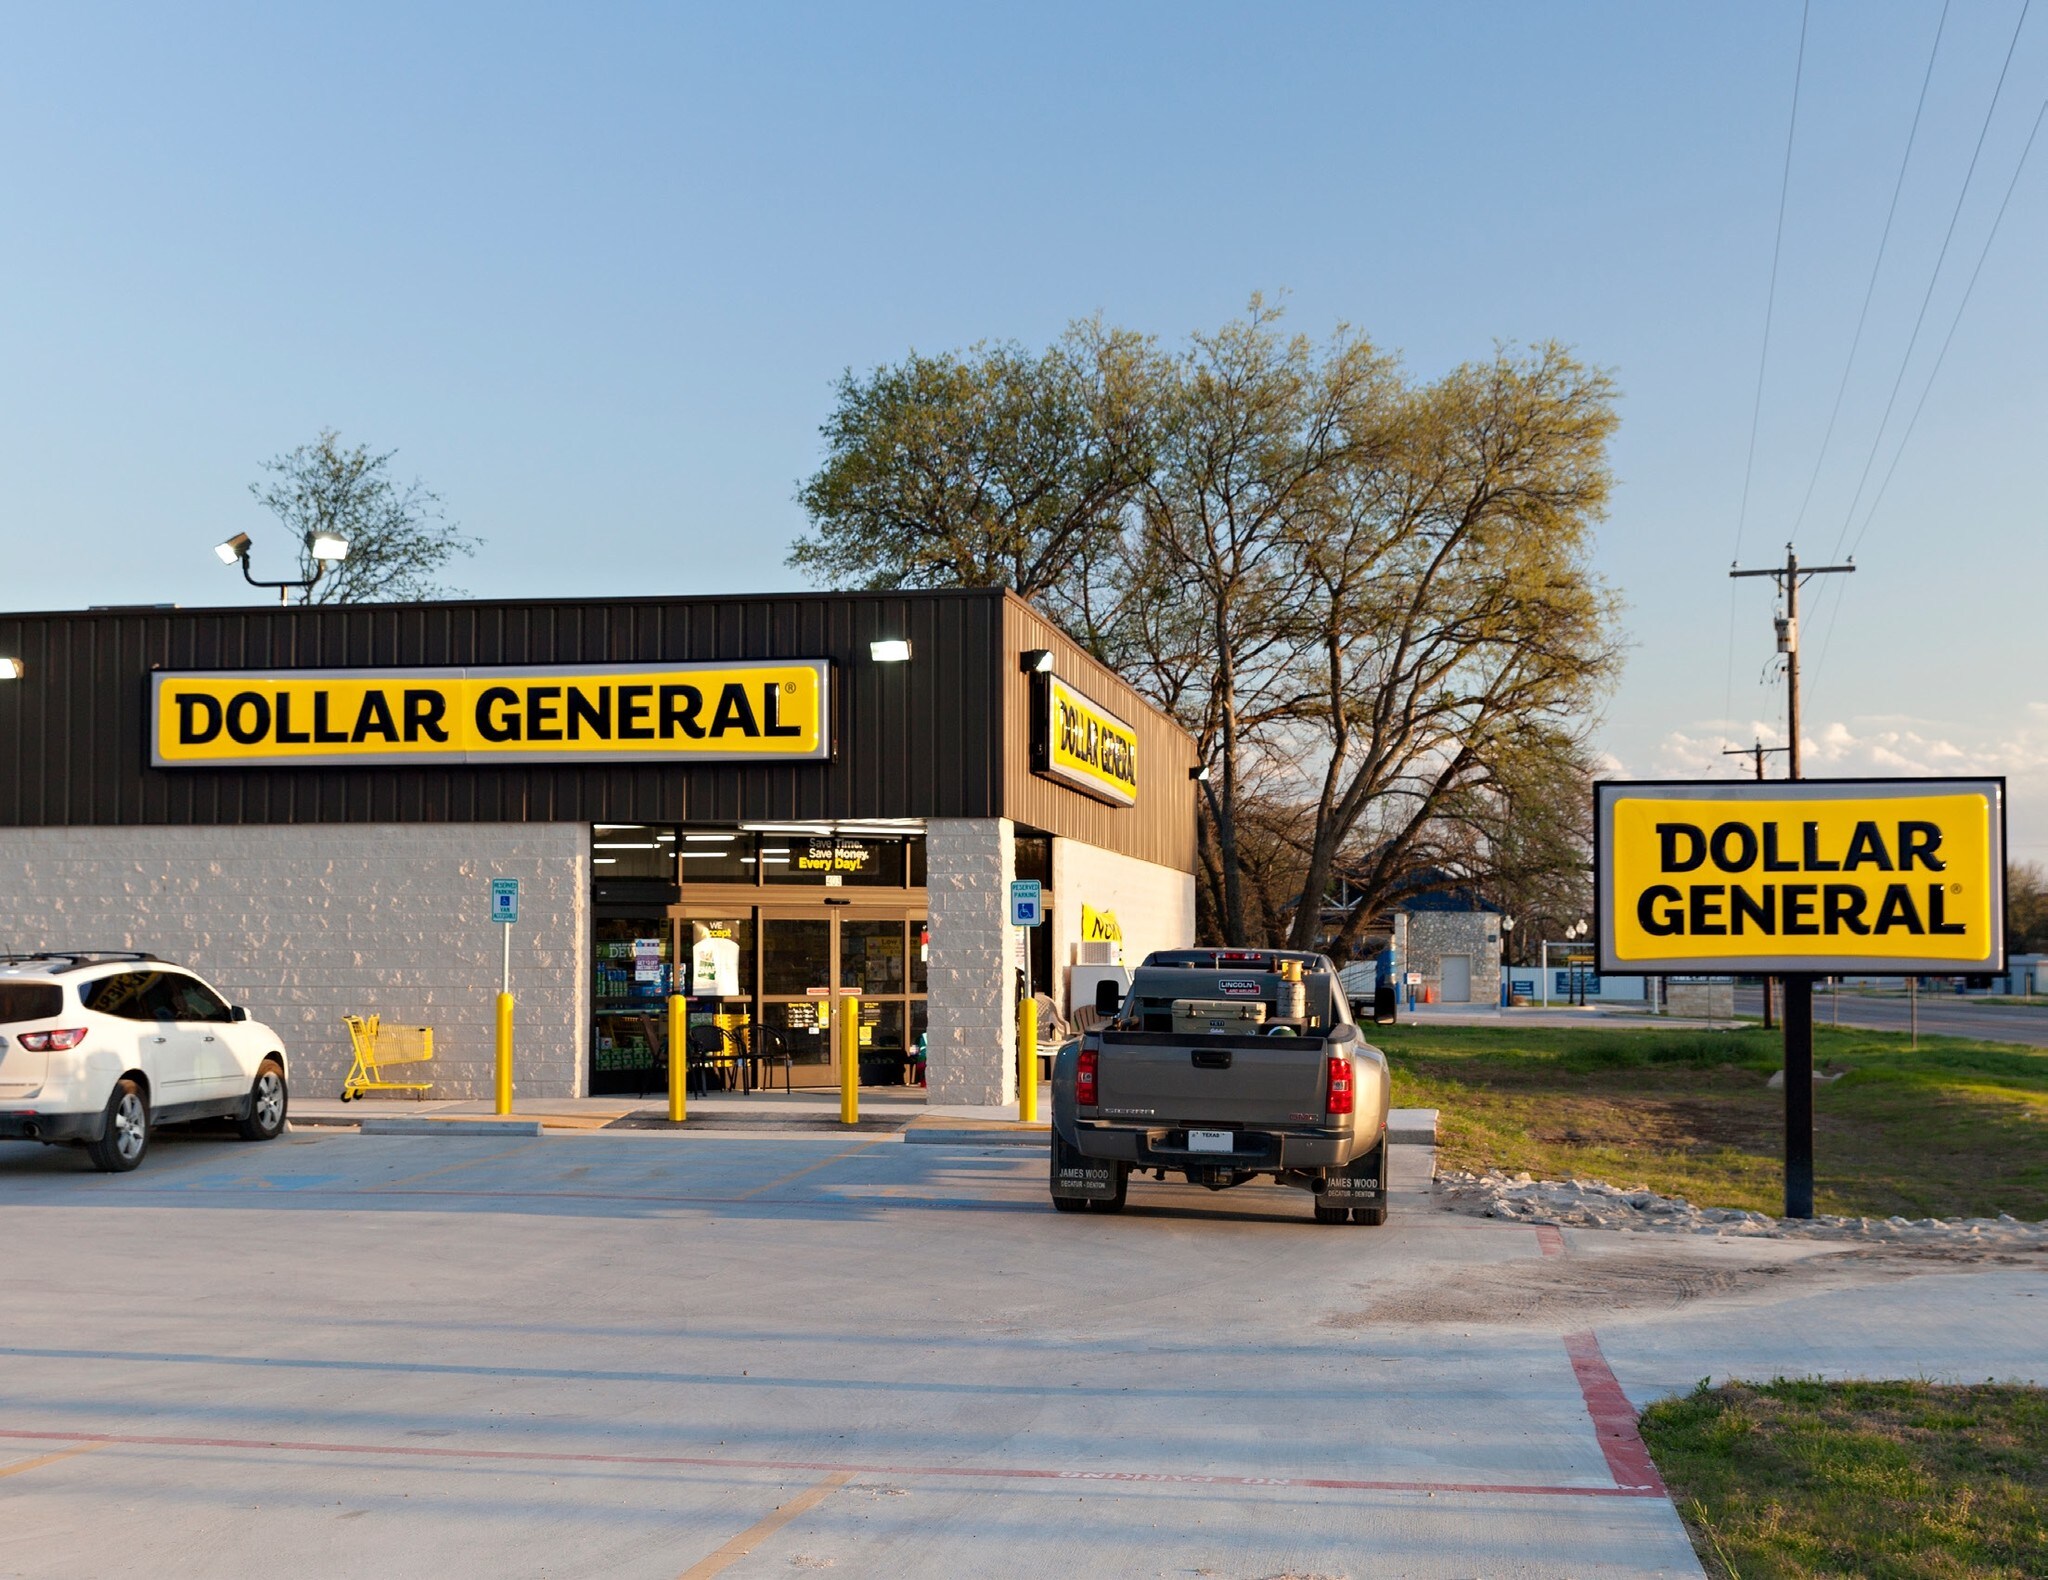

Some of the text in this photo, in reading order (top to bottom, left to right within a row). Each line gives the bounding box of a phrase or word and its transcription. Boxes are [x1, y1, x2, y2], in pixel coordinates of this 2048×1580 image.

[175, 690, 450, 746] DOLLAR
[474, 682, 801, 743] GENERAL
[1060, 700, 1136, 787] DOLLAR GENERAL
[809, 838, 863, 849] Save Time.
[1656, 821, 1947, 874] DOLLAR
[809, 848, 833, 859] Save
[799, 857, 833, 871] Every
[1637, 883, 1967, 936] GENERAL
[709, 921, 723, 929] WE
[1288, 1112, 1319, 1122] GMC
[1059, 1168, 1109, 1179] JAMES WOOD
[1327, 1177, 1378, 1188] JAMES WOOD
[1057, 1470, 1291, 1486] NO PARKING
